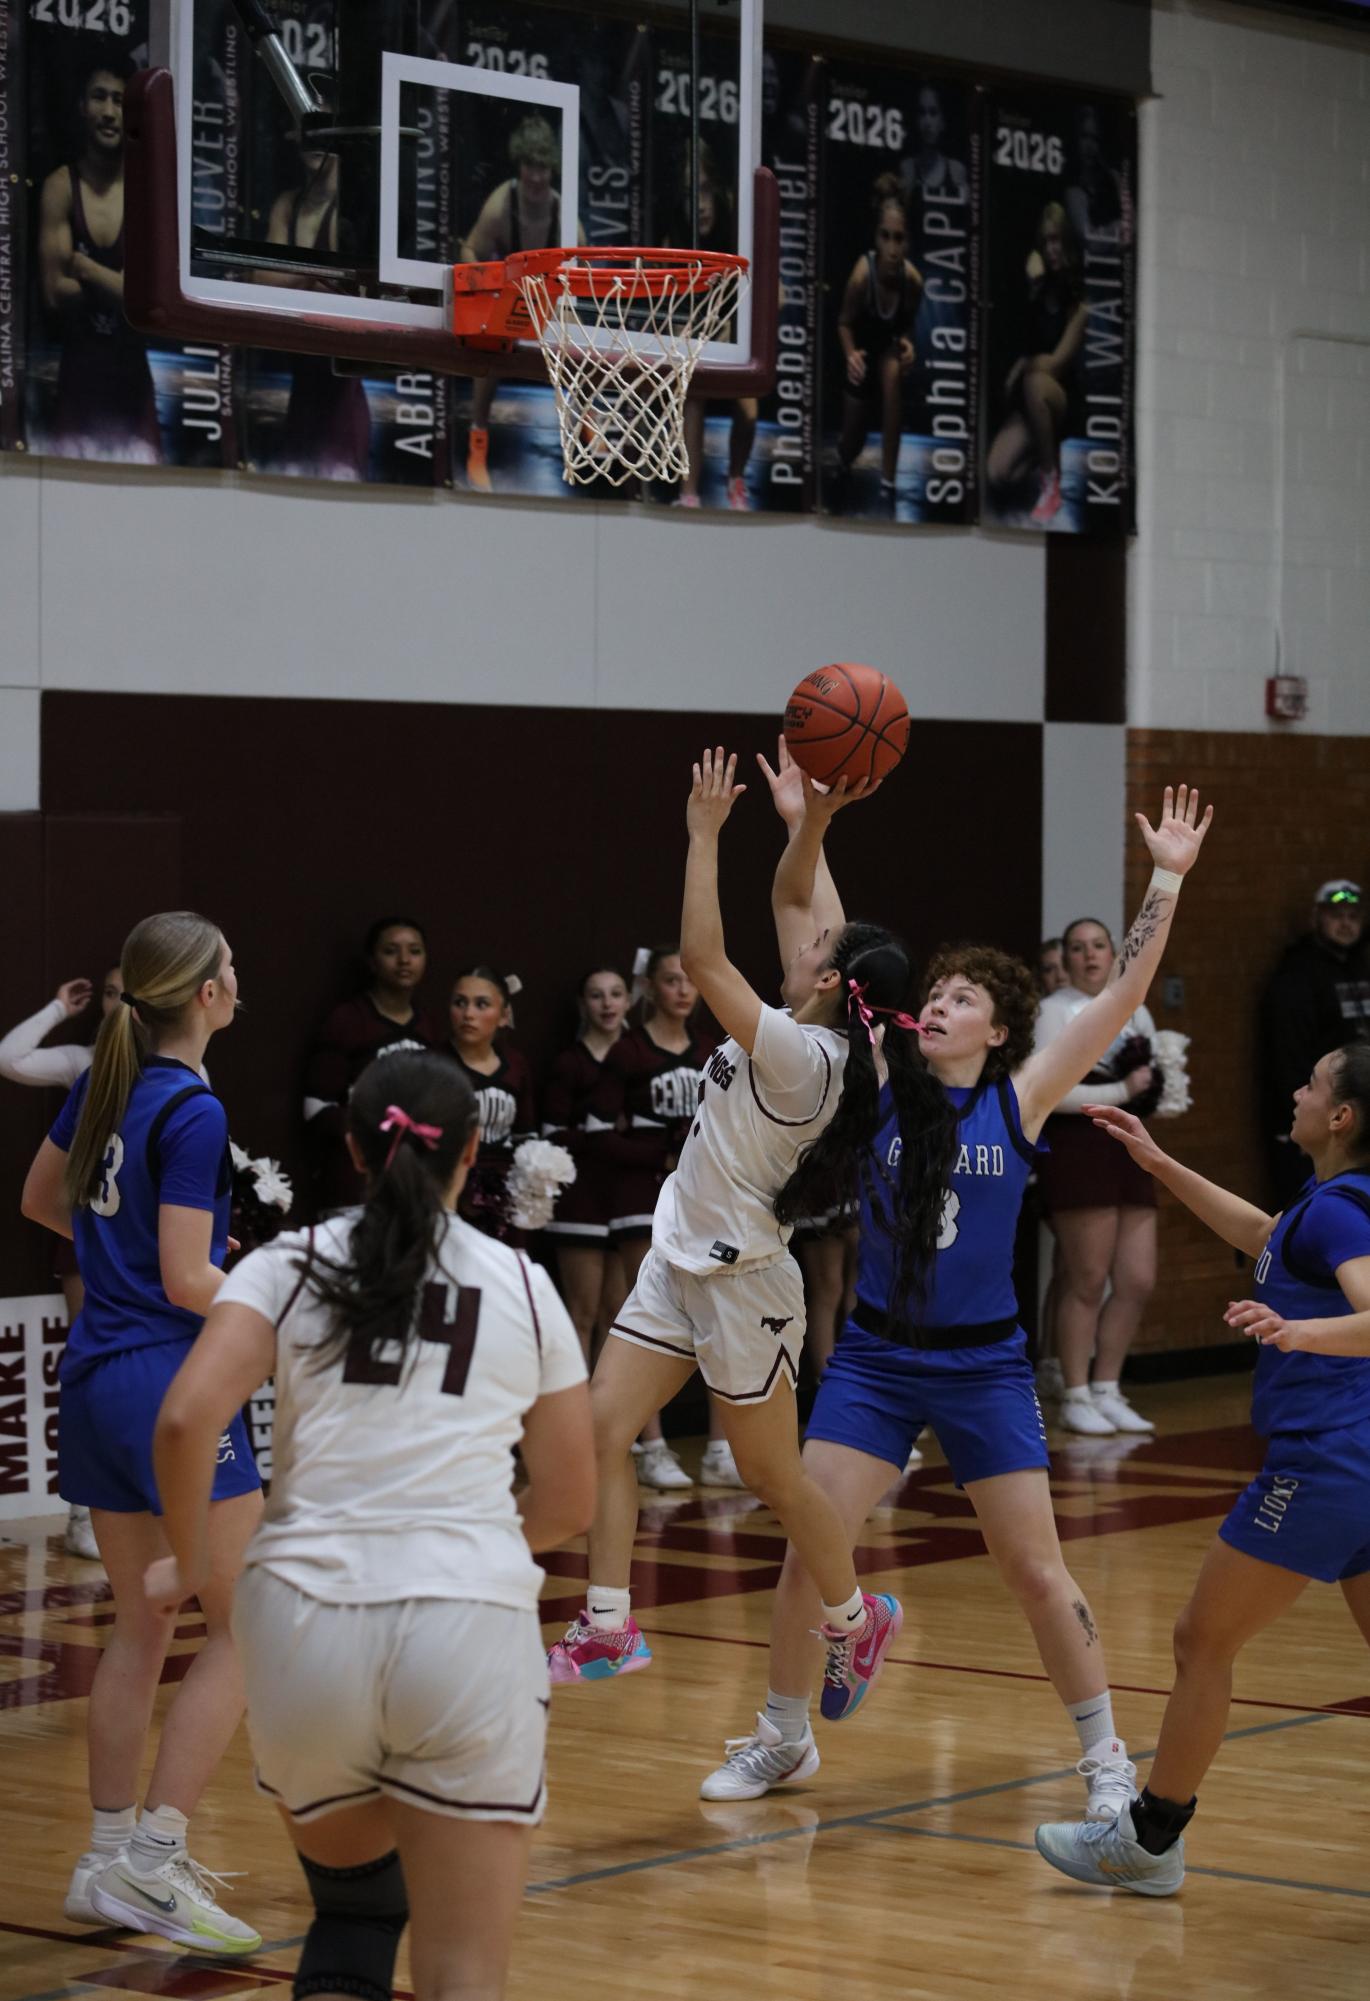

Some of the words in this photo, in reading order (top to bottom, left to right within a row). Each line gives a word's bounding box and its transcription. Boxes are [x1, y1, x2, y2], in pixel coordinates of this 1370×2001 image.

[33, 0, 131, 36] 2026
[225, 24, 238, 127] WRESTLING
[657, 69, 739, 124] 2026
[828, 98, 904, 151] 2026
[996, 127, 1062, 175] 2026
[0, 177, 9, 225] HIGH
[225, 136, 238, 209] SCHOOL
[438, 162, 450, 235] SCHOOL
[0, 233, 11, 315] CENTRAL
[922, 184, 968, 304] CAPE
[1084, 225, 1122, 368] WAITE
[0, 321, 14, 388] SALINA
[221, 354, 233, 417] SALINA
[394, 373, 434, 458] ABR
[770, 324, 807, 485] Phoebe
[924, 326, 970, 504] Sophia
[1085, 394, 1121, 504] KODI
[342, 1281, 481, 1396] 24
[0, 1323, 28, 1494] MAKE
[1254, 1475, 1299, 1534] LIONS
